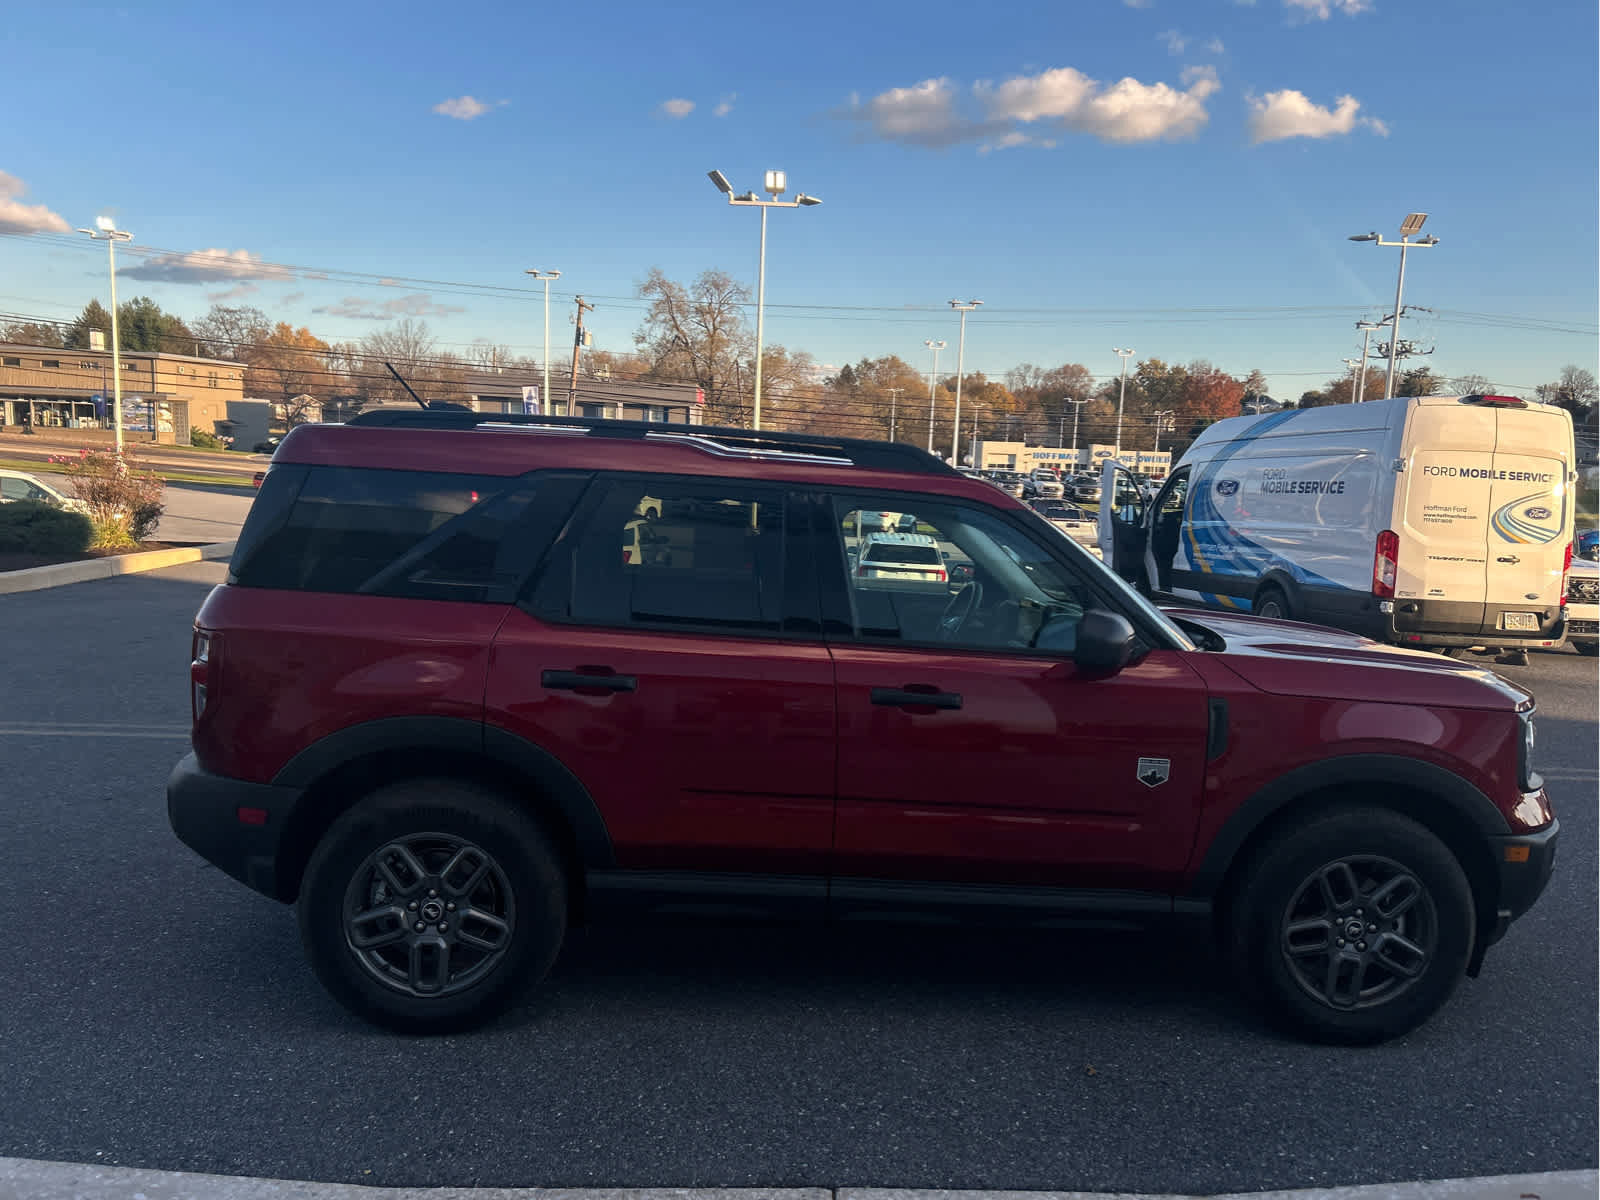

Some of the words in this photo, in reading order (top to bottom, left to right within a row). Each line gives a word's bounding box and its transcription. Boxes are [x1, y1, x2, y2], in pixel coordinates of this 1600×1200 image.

[1263, 469, 1287, 480] FORD
[1424, 466, 1457, 477] FORD
[1459, 468, 1506, 480] MOBILE
[1261, 481, 1296, 494] MOBILE
[1298, 481, 1345, 494] SERVICE
